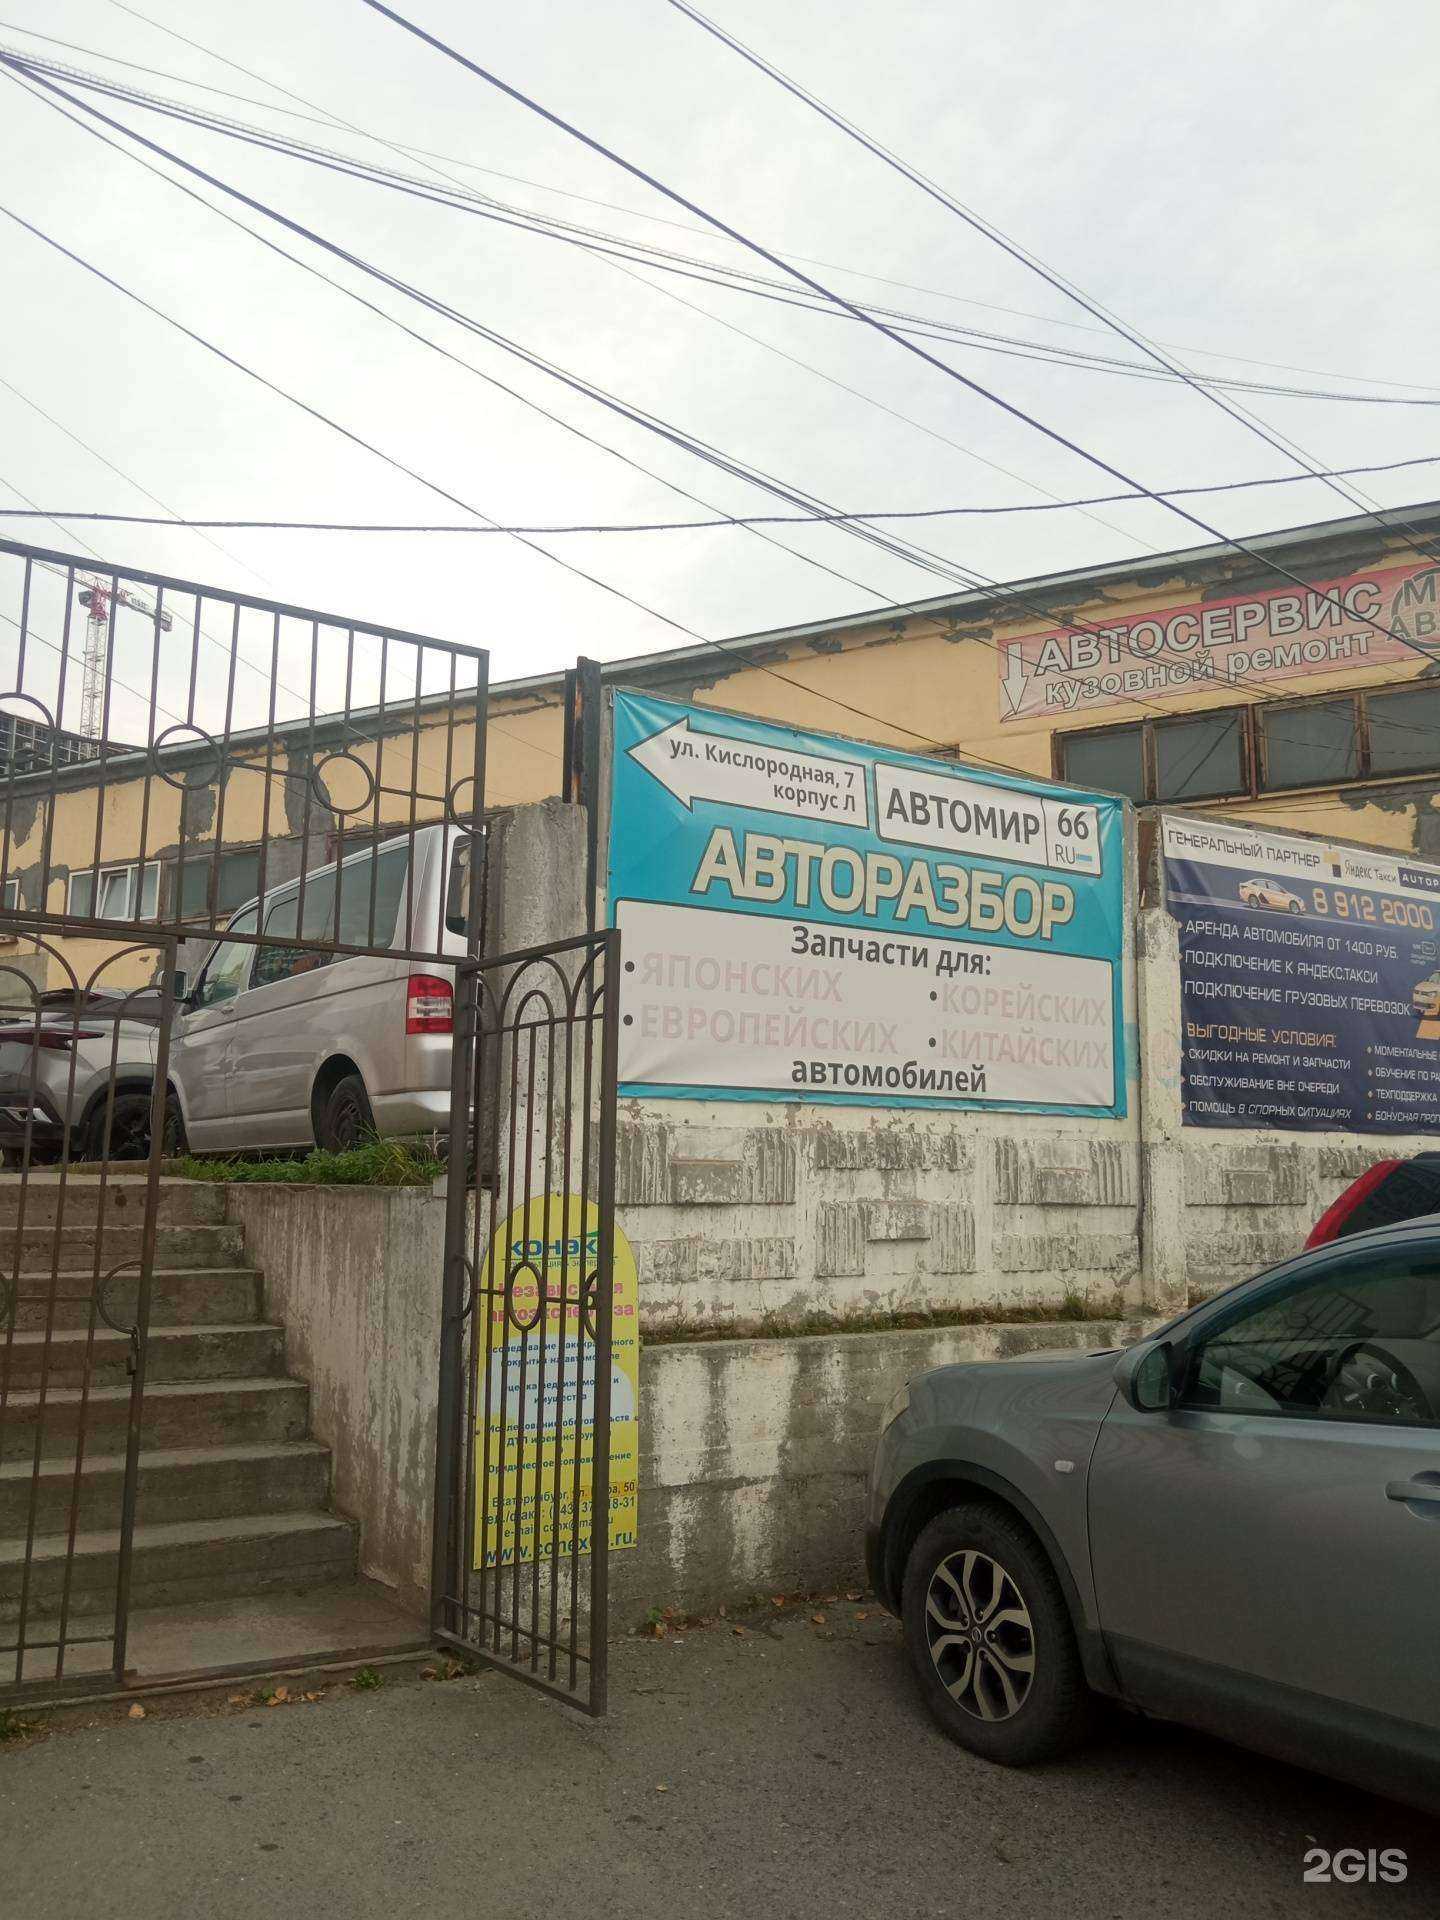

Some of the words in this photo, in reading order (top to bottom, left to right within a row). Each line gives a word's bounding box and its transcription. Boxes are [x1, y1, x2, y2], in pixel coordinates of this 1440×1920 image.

[1034, 581, 1382, 678] АВТОСЕРВИС
[1045, 650, 1215, 710] кузовной
[1227, 630, 1374, 684] ремонт
[669, 738, 700, 759] ул.
[705, 742, 840, 788] Кислородная,
[844, 771, 855, 788] 7
[774, 784, 838, 812] корпус
[843, 794, 856, 812] Л
[886, 787, 1040, 845] АВТОМИР
[1057, 808, 1090, 840] 66
[1055, 844, 1076, 864] RU
[1168, 830, 1264, 859] ГЕНЕРАЛЬНЫЙ
[1266, 847, 1321, 869] ПАРТНЕР
[1344, 859, 1373, 880] Яндекс
[690, 827, 1076, 941] АВТОРАЗБОР
[1312, 887, 1329, 914] 8
[1333, 890, 1377, 921] 912
[1380, 898, 1434, 930] 2000
[791, 925, 929, 968] Запчасти
[936, 948, 991, 978] для:
[1185, 919, 1240, 940] АРЕНДА
[1243, 926, 1324, 949] АВТОМОБИЛЯ
[1327, 936, 1341, 951] ОТ
[1345, 939, 1373, 956] 1400
[1376, 944, 1400, 959] РУБ.
[640, 952, 844, 1002] ЯПОНСКИХ
[1184, 949, 1282, 974] ПОДКЛЮЧЕНИЕ
[1285, 960, 1294, 975] К
[1297, 962, 1379, 984] ЯНДЕКС.ТАКСИ
[942, 981, 1107, 1027] КОРЕЙСКИХ
[1183, 980, 1282, 1003] ПОДКЛЮЧЕНИЕ
[1285, 990, 1348, 1010] ГРУЗОВЫХ
[1350, 996, 1411, 1016] ПЕРЕВОЗОК
[640, 1003, 899, 1054] ЕВРОПЕЙСКИХ
[940, 1026, 1109, 1070] КИТАЙСКИХ
[1186, 1022, 1267, 1044] ВЫГОДНЫЕ
[1271, 1029, 1338, 1048] УСЛОВИЯ:
[791, 1060, 987, 1093] автомобилей
[1188, 1047, 1233, 1063] СКИДКИ
[1235, 1052, 1250, 1064] НА
[1252, 1053, 1290, 1067] РЕМОНТ
[1293, 1056, 1300, 1067] И
[1302, 1056, 1352, 1071] ЗАПЧАСТИ
[1189, 1073, 1275, 1091] ОБСЛУЖИВАНИЕ
[1277, 1080, 1295, 1092] ВНЕ
[1297, 1080, 1340, 1096] ОЧЕРЕДИ
[1188, 1101, 1236, 1116] ПОМОЩЬ
[1238, 1103, 1246, 1115] В
[1248, 1104, 1296, 1117] СПОРНЫХ
